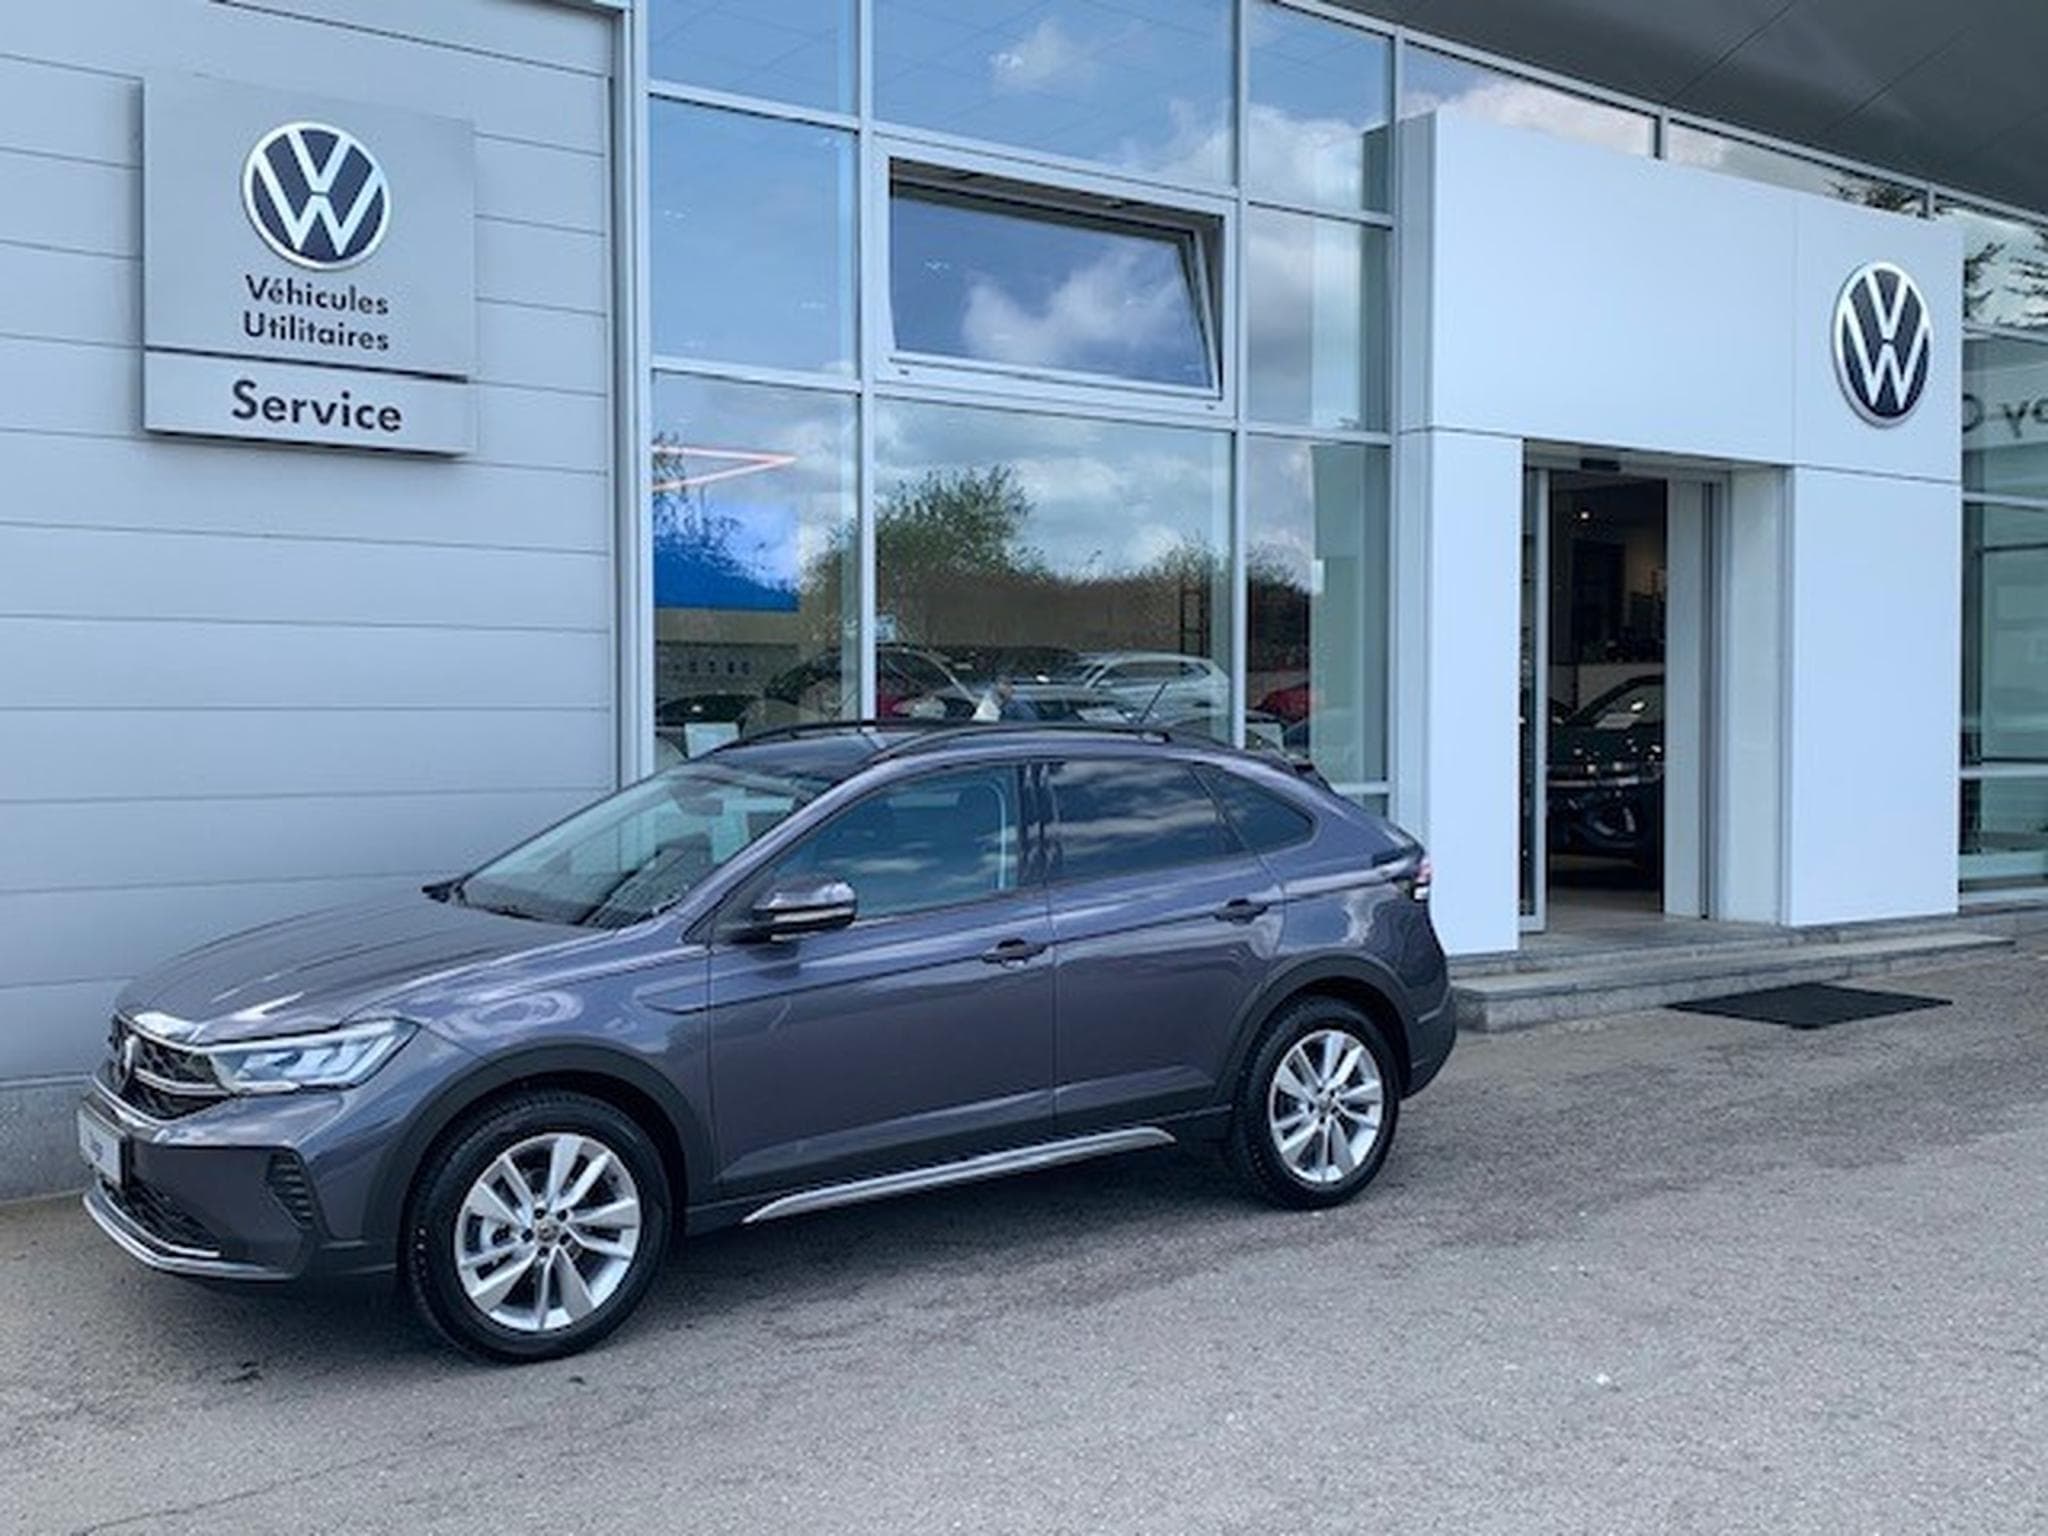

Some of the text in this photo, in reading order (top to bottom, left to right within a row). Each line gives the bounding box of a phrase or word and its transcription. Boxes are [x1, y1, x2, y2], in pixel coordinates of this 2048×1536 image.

[244, 123, 390, 269] VW
[245, 274, 389, 315] Véhicules
[244, 311, 389, 351] Utilitaires
[1833, 262, 1932, 427] VW
[232, 379, 403, 433] Service
